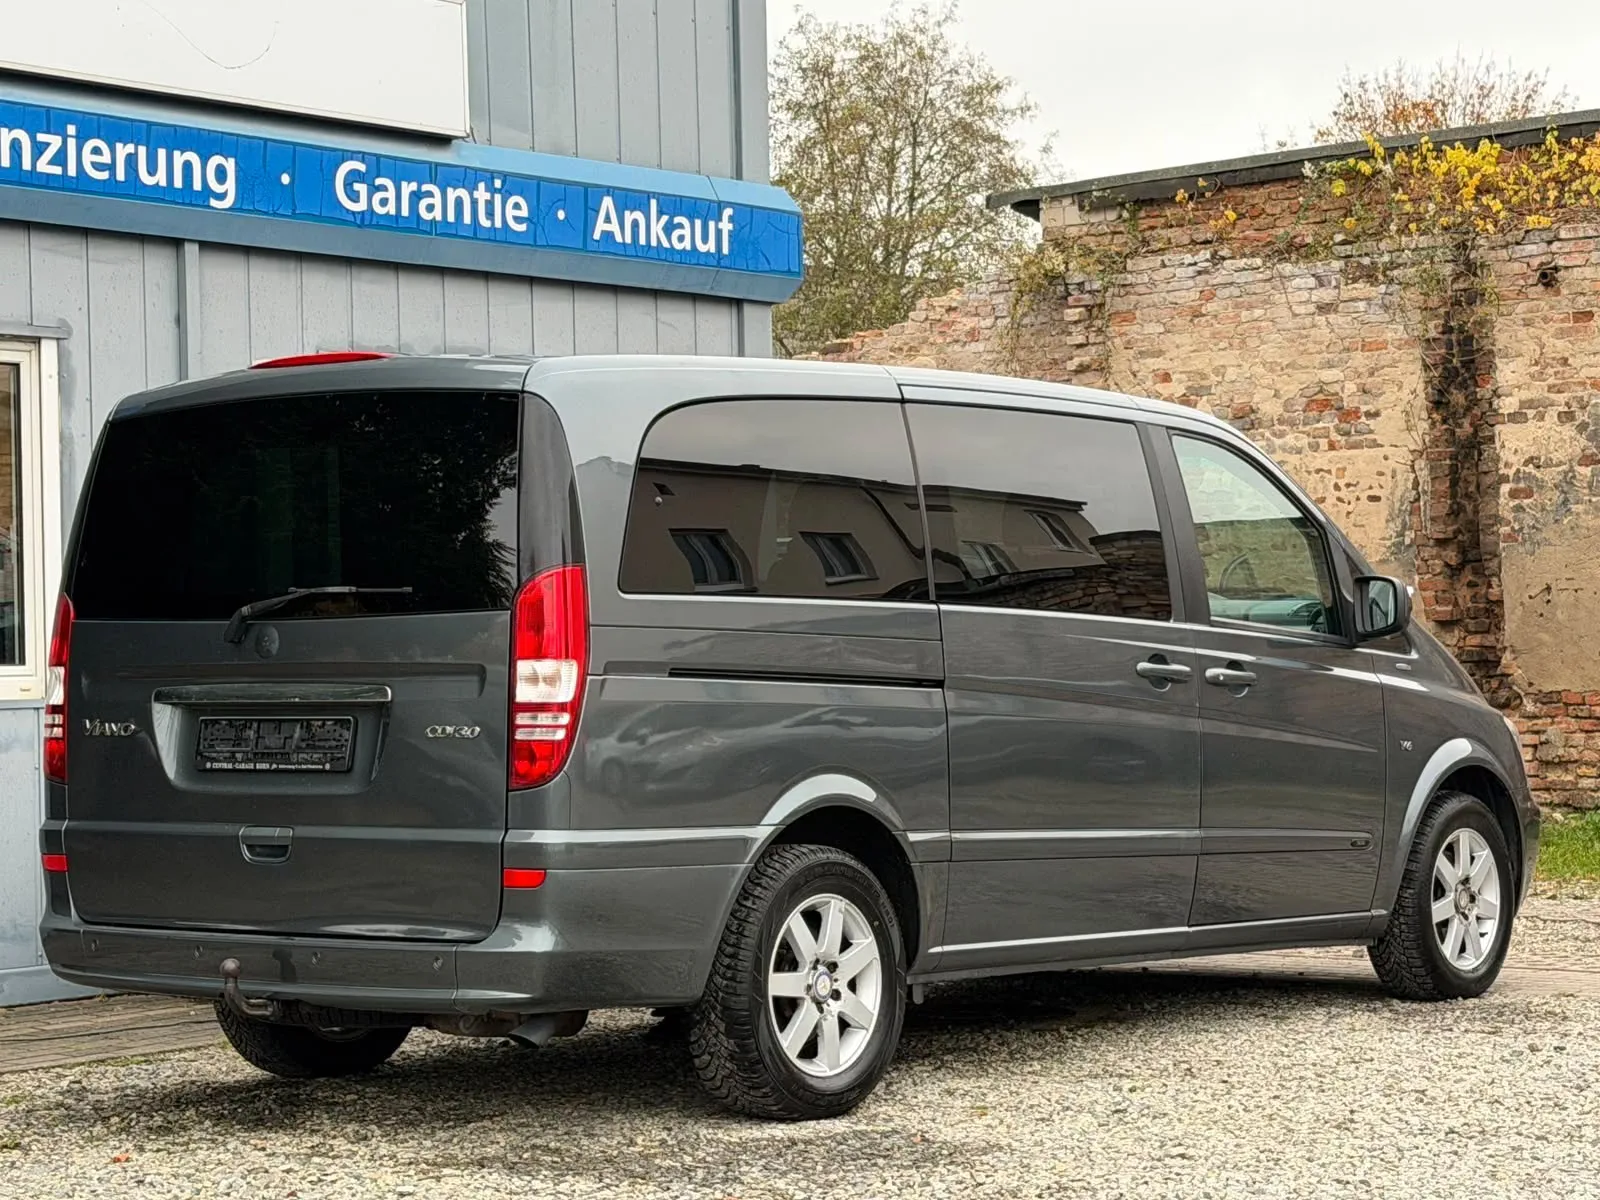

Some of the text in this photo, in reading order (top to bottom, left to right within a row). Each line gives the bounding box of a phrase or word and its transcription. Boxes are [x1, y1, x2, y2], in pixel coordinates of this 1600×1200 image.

[0, 125, 733, 254] nzierung Garantie Ankauf
